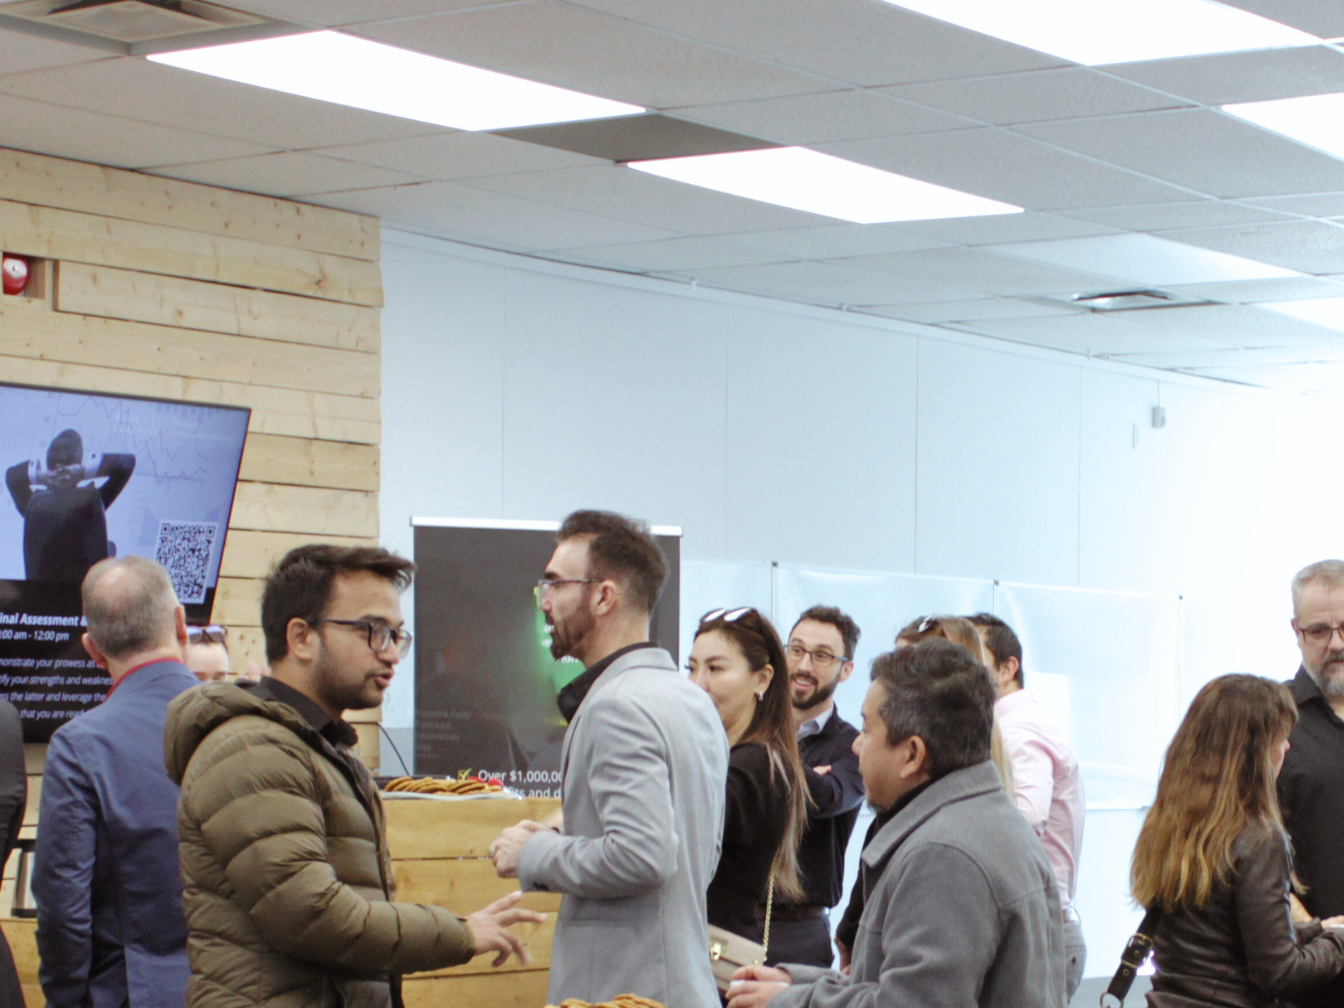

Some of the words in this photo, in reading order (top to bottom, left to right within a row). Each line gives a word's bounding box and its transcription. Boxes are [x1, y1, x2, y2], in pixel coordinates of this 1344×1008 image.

[0, 612, 19, 624] inal
[20, 613, 79, 626] Assessment
[14, 631, 27, 640] am
[33, 630, 55, 641] 12:00
[55, 632, 70, 643] pm
[35, 659, 53, 670] your
[54, 660, 85, 670] prowess
[11, 676, 30, 687] your
[30, 675, 65, 688] strengths
[66, 675, 82, 685] and
[82, 676, 114, 686] weaknes
[10, 691, 23, 701] the
[24, 691, 45, 702] latter
[45, 692, 61, 702] and
[62, 692, 93, 704] leverage
[20, 708, 36, 719] that
[36, 711, 51, 721] you
[52, 711, 65, 719] are
[477, 768, 507, 782] Over
[528, 786, 550, 798] and
